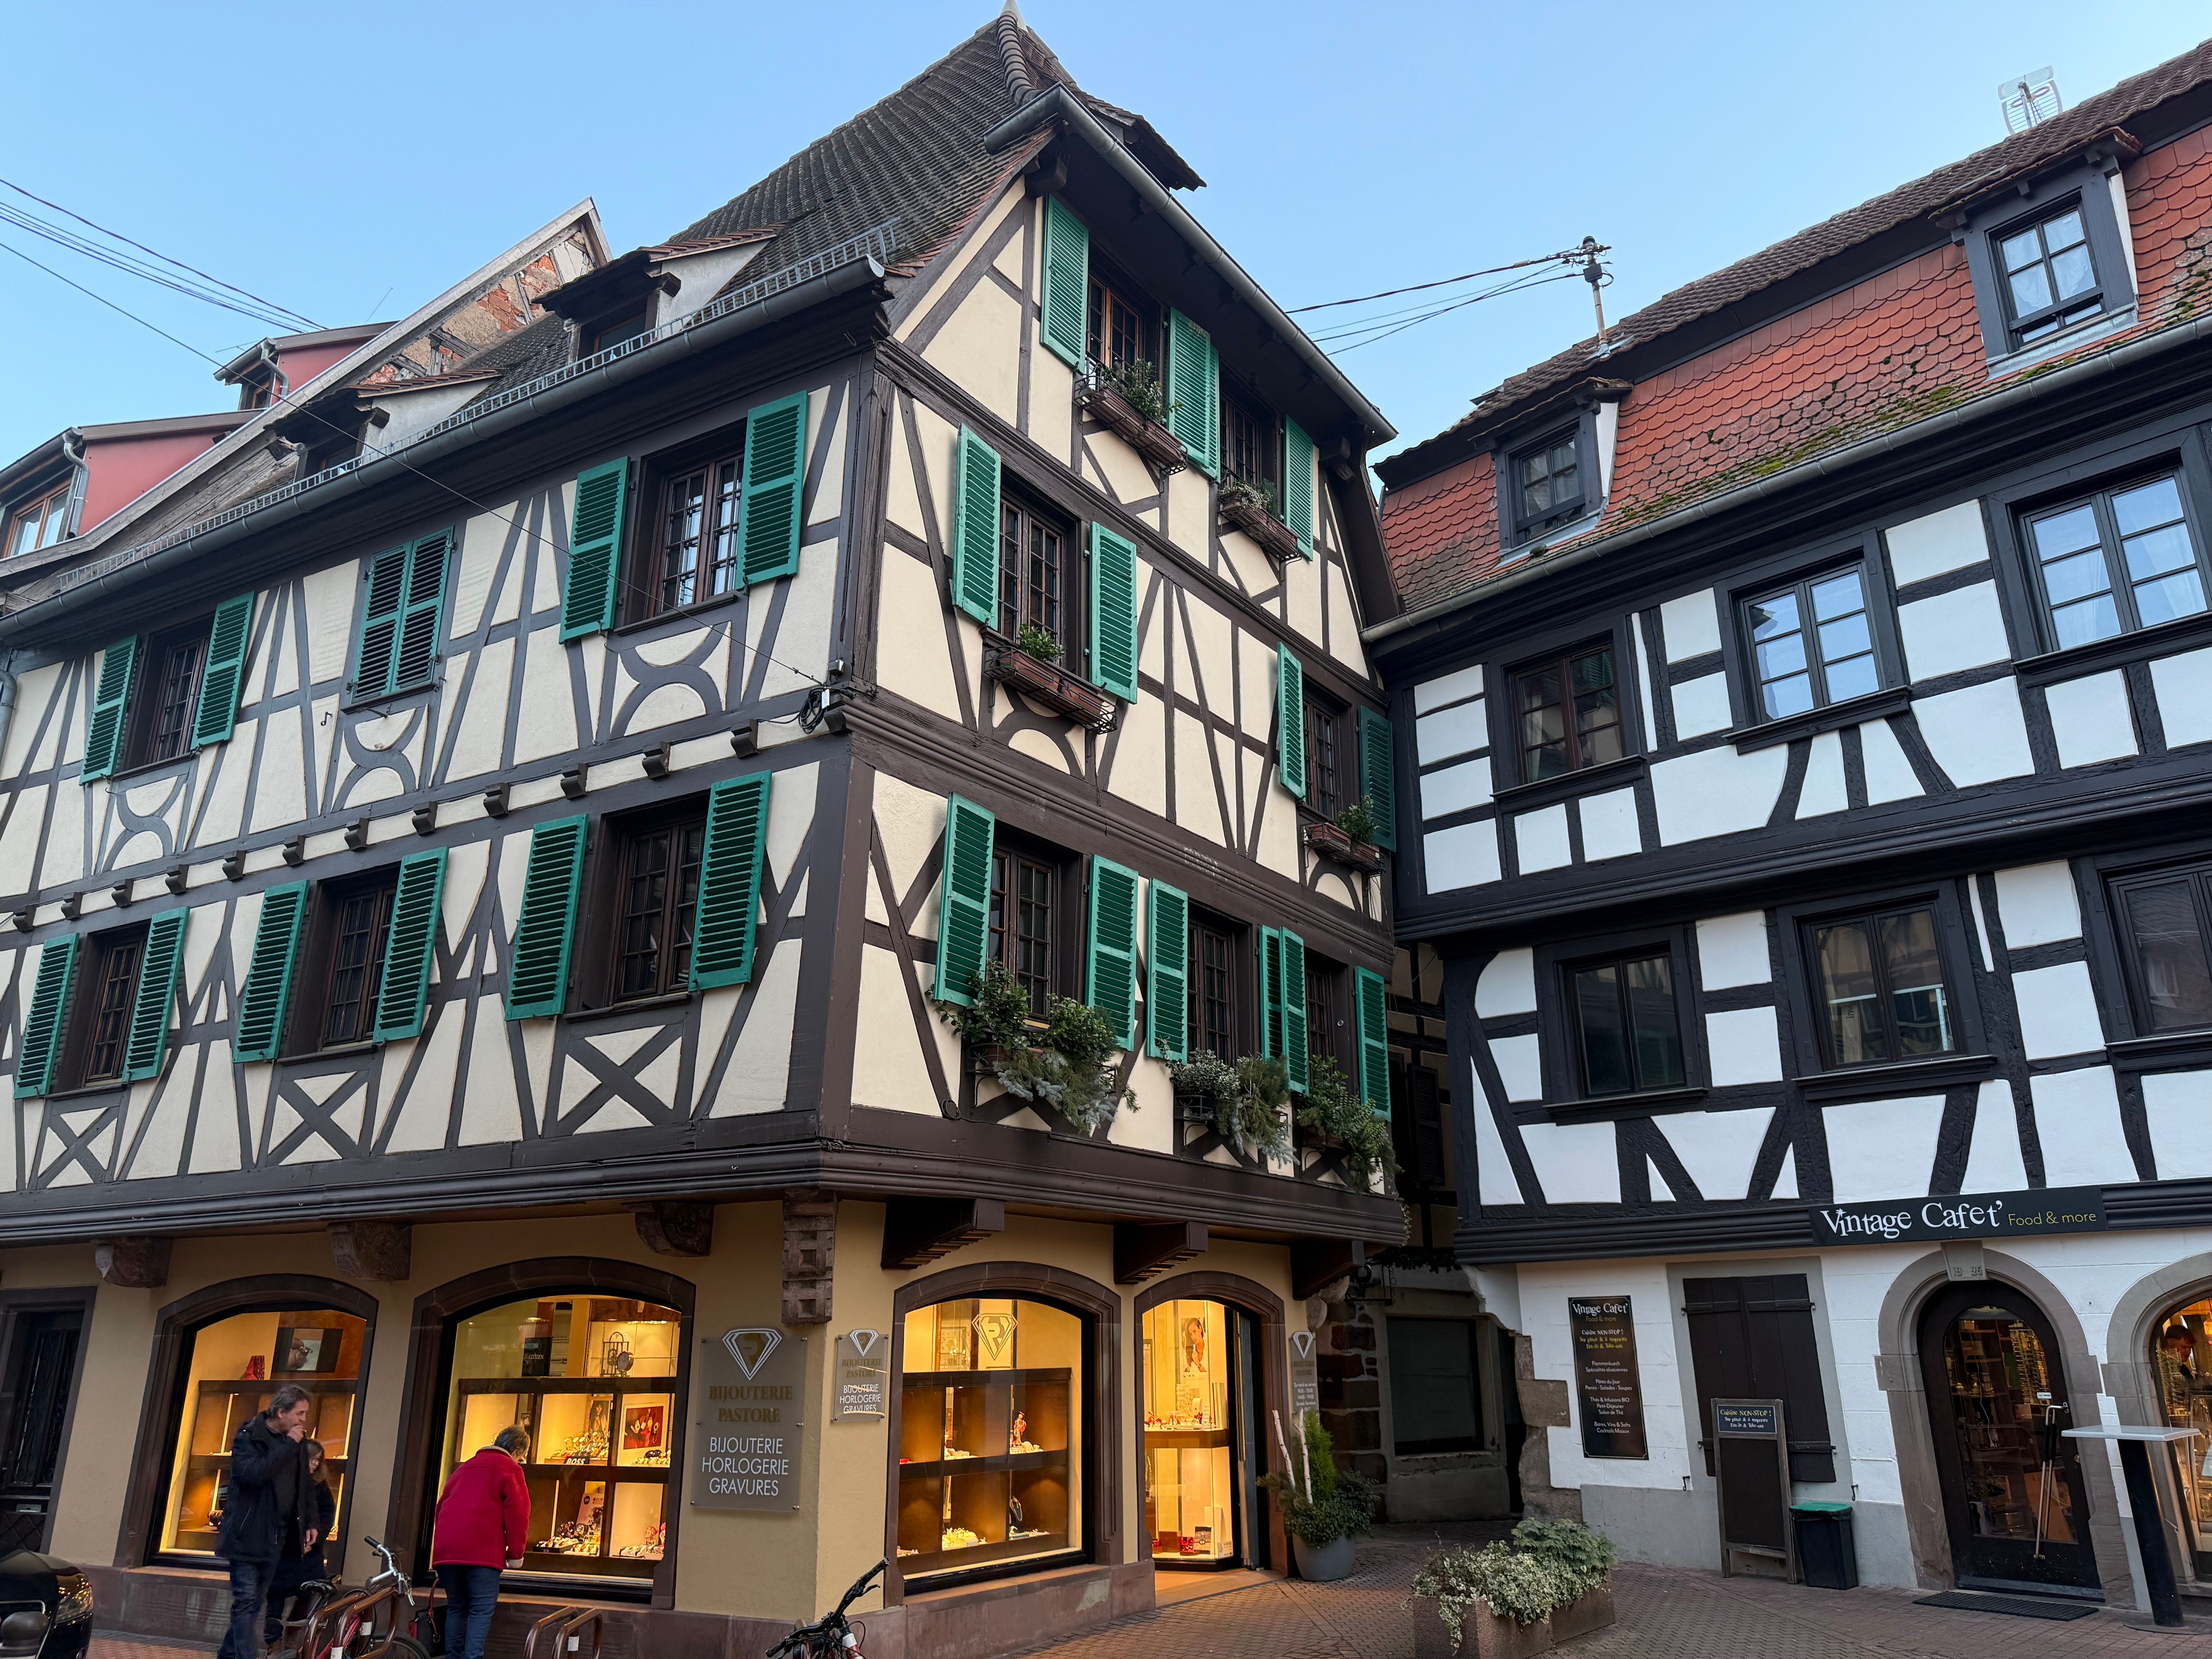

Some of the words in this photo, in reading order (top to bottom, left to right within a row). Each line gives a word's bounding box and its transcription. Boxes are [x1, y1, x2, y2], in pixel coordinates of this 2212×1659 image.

[1820, 1208, 1912, 1239] Vintage
[1922, 1200, 2002, 1229] Cafet'
[2008, 1212, 2042, 1226] Food
[2046, 1211, 2059, 1224] &
[2062, 1212, 2097, 1223] more
[1572, 1304, 1601, 1316] Vintage
[842, 1358, 882, 1367] BIJOUTERIE
[709, 1386, 792, 1403] BIJOUTERIE
[843, 1384, 879, 1394] BIJOUTERIE
[840, 1394, 881, 1404] HORLOGERIE
[717, 1407, 781, 1423] PASTORE
[710, 1437, 783, 1454] BIJOUTERIE
[702, 1457, 789, 1475] HORLOGERIE
[709, 1478, 778, 1496] GRAVURES
